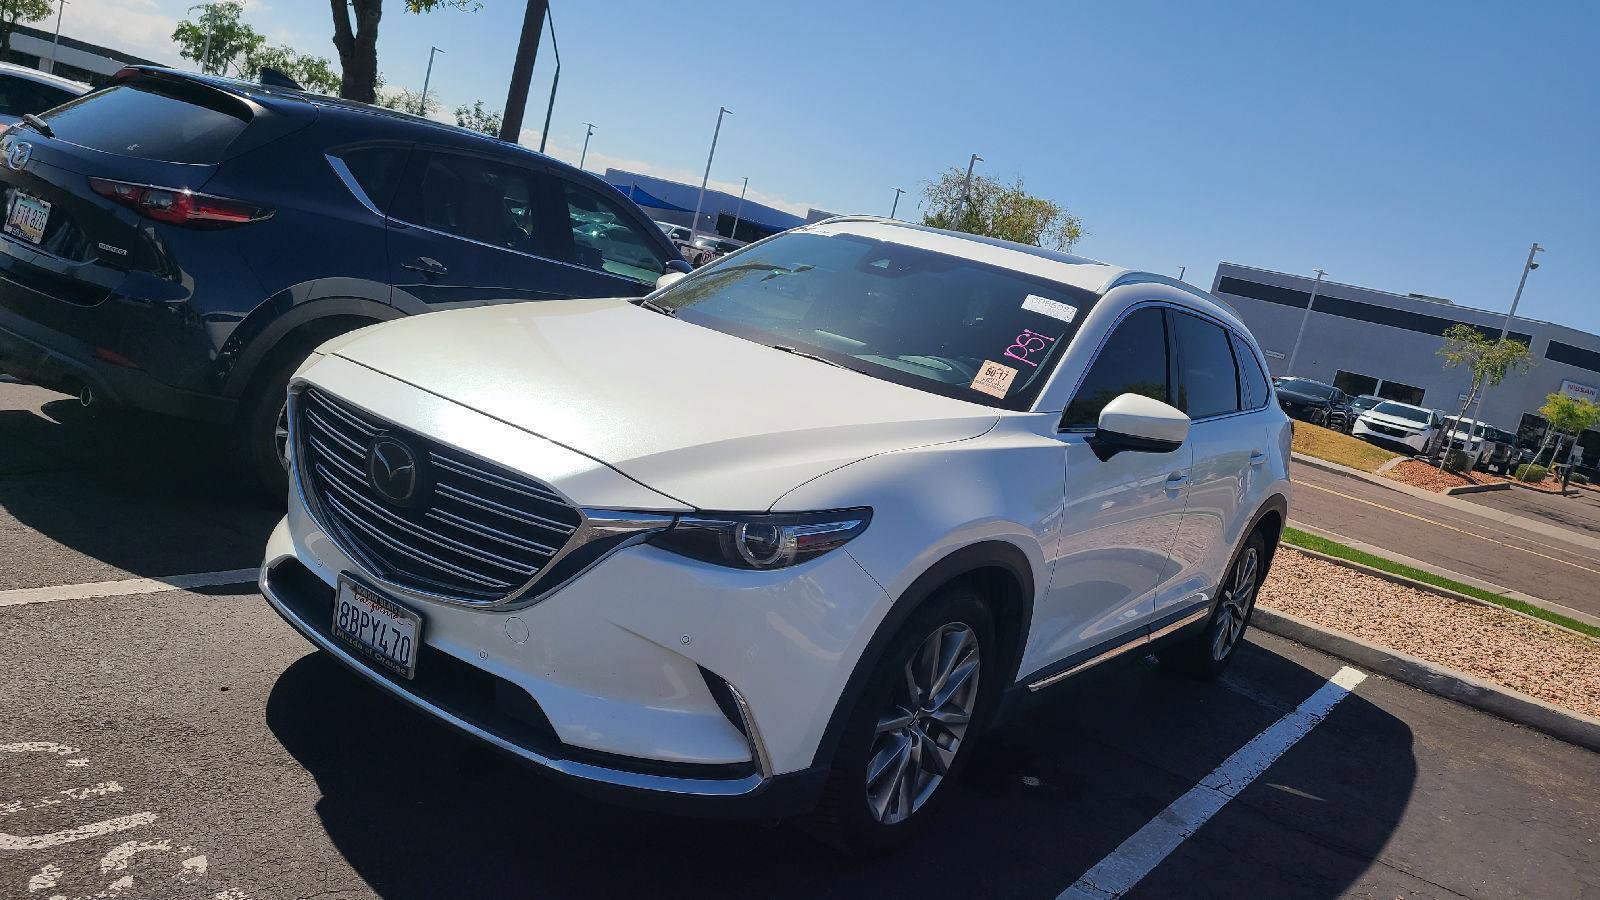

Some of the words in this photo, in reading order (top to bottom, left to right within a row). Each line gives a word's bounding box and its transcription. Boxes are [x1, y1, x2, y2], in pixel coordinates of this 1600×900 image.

[1567, 384, 1596, 396] NISSAN
[354, 592, 400, 620] California
[336, 629, 363, 650] Mazda
[340, 600, 411, 666] 8BPY470
